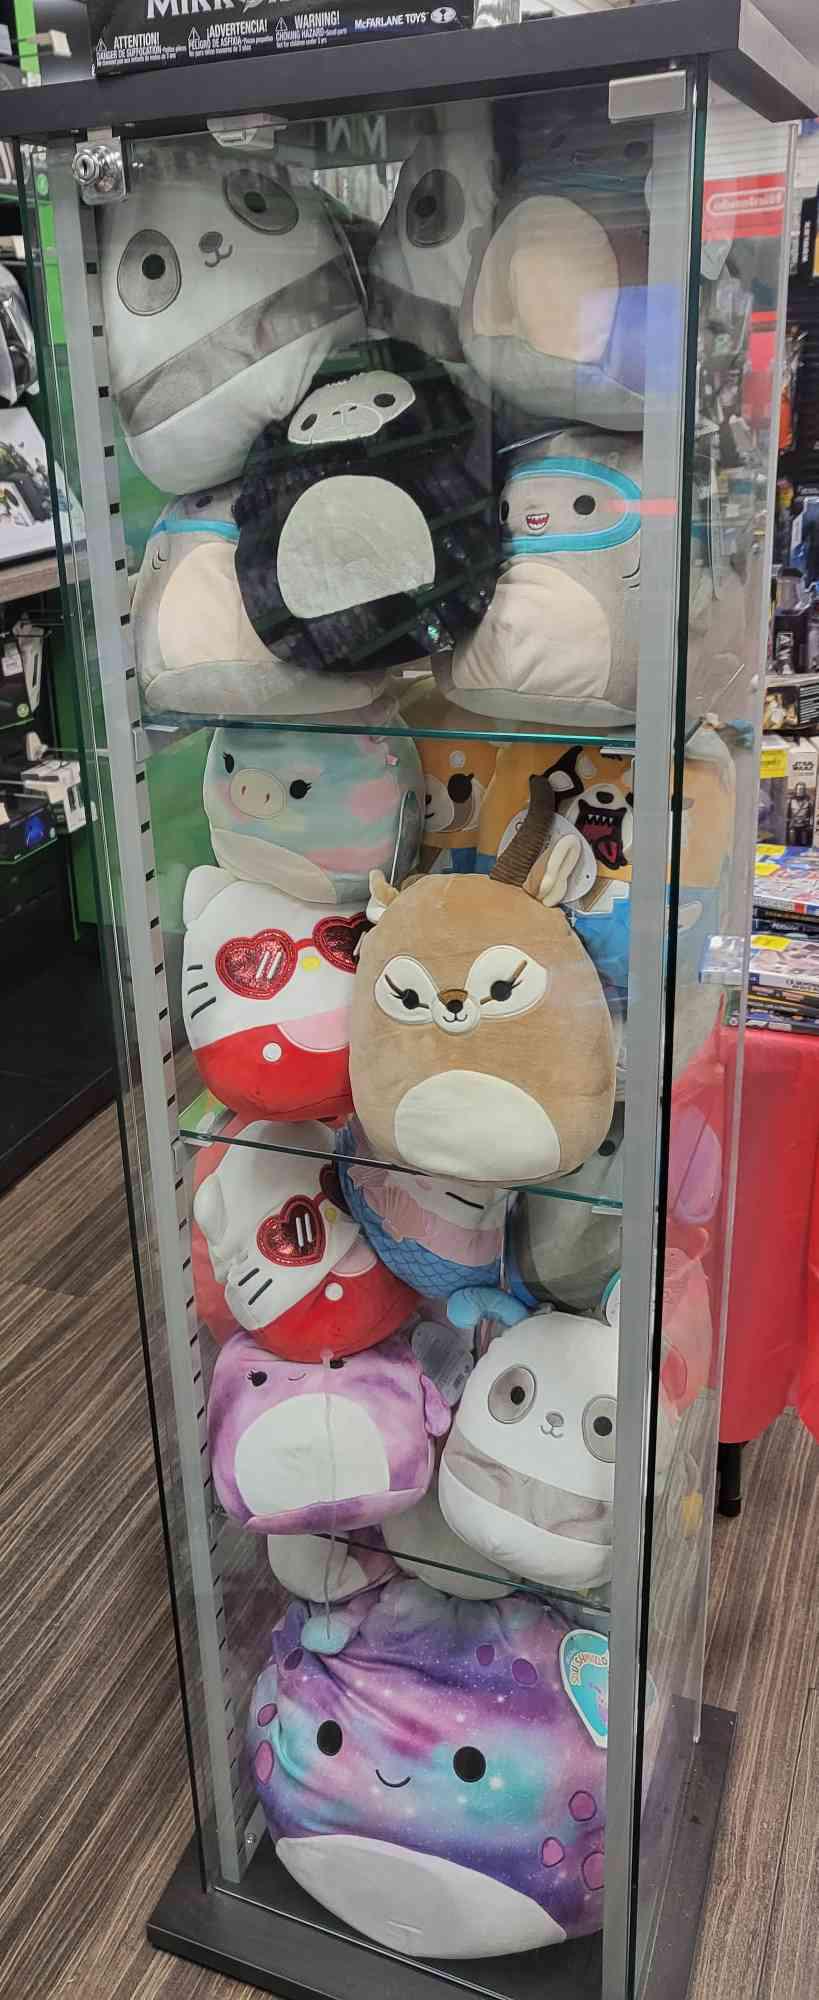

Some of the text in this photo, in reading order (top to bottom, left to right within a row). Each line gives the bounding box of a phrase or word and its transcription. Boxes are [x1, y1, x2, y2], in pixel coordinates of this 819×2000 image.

[294, 10, 340, 29] WARNING!
[354, 12, 426, 30] McFARLANE TOYS
[206, 18, 268, 40] ¡ADVERTENCIA!
[113, 32, 160, 49] ATTENTION!
